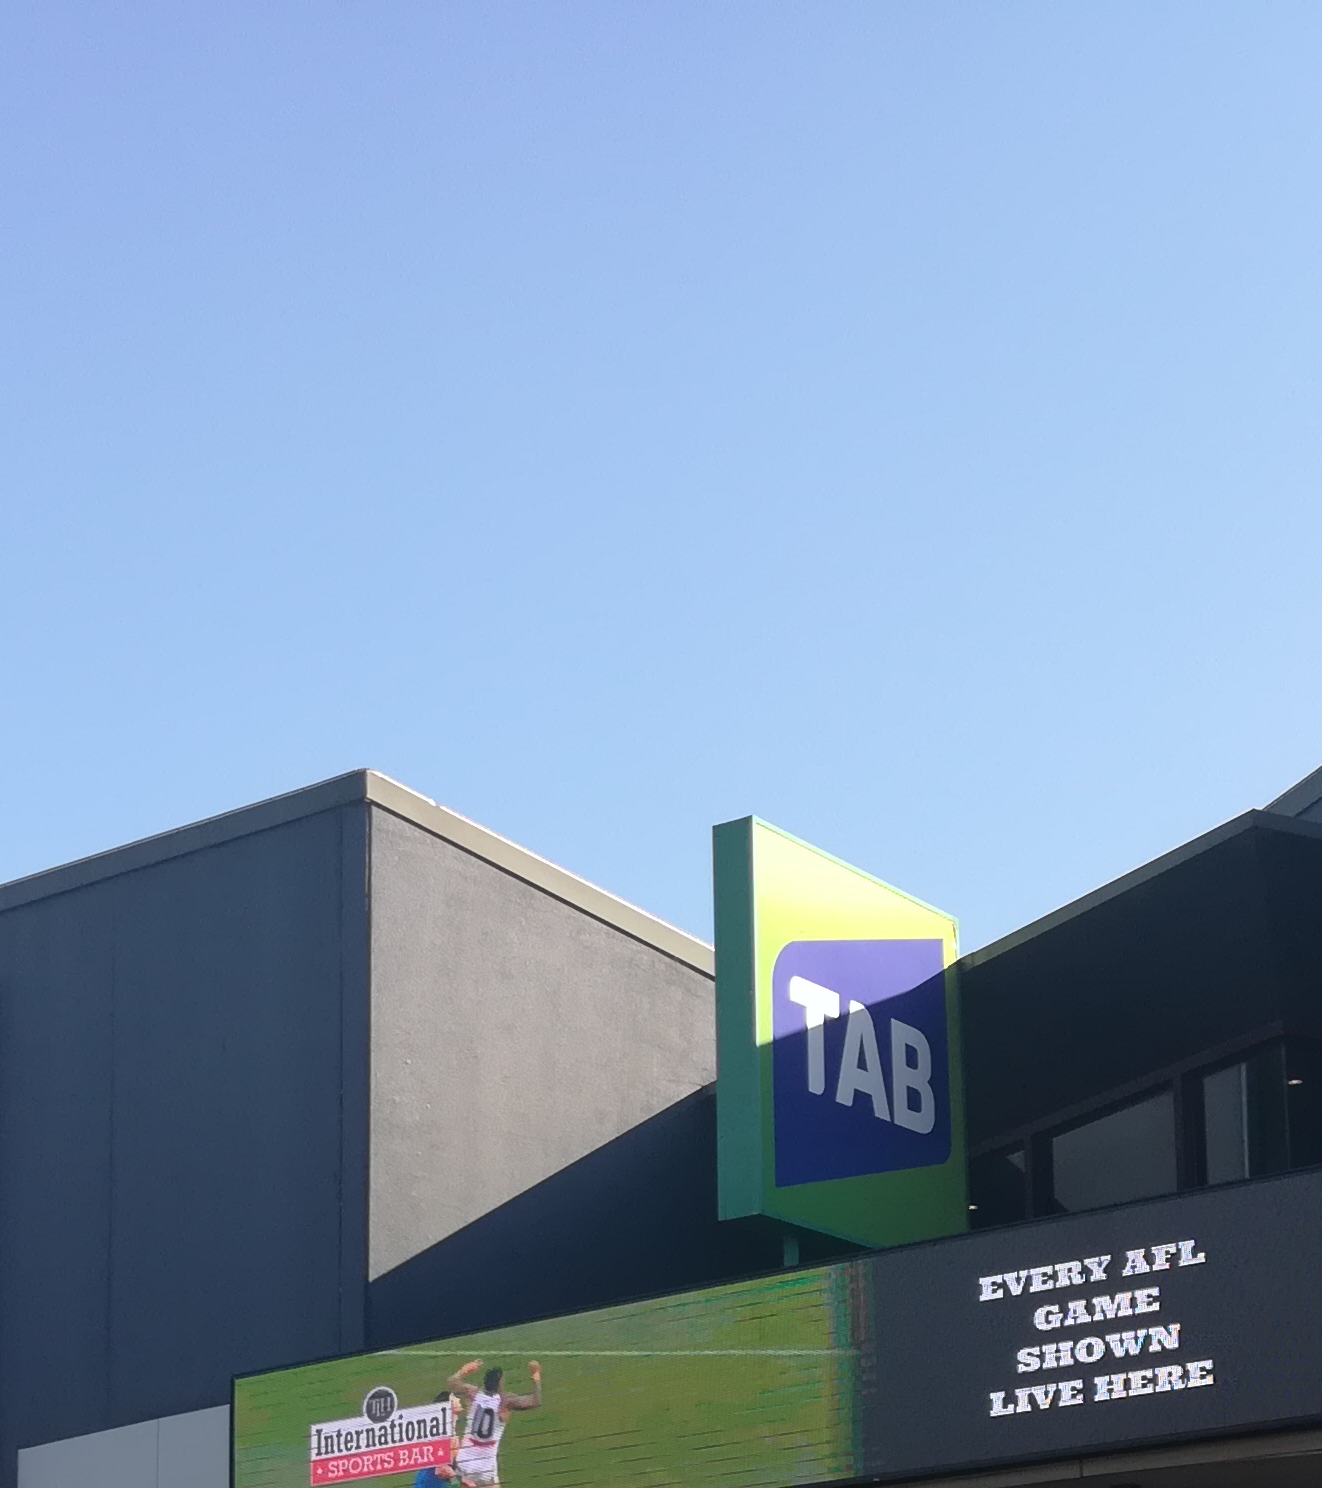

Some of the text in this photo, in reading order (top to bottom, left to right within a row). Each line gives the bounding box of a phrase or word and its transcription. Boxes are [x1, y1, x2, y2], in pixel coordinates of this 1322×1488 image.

[789, 975, 936, 1134] TAB
[979, 1239, 1206, 1302] EVERY AFL
[1033, 1286, 1161, 1331] GAME
[1016, 1323, 1181, 1374] SHOWN
[989, 1359, 1214, 1417] LIVE HERE
[315, 1406, 448, 1457] International
[327, 1444, 434, 1479] SPORTS BAR
